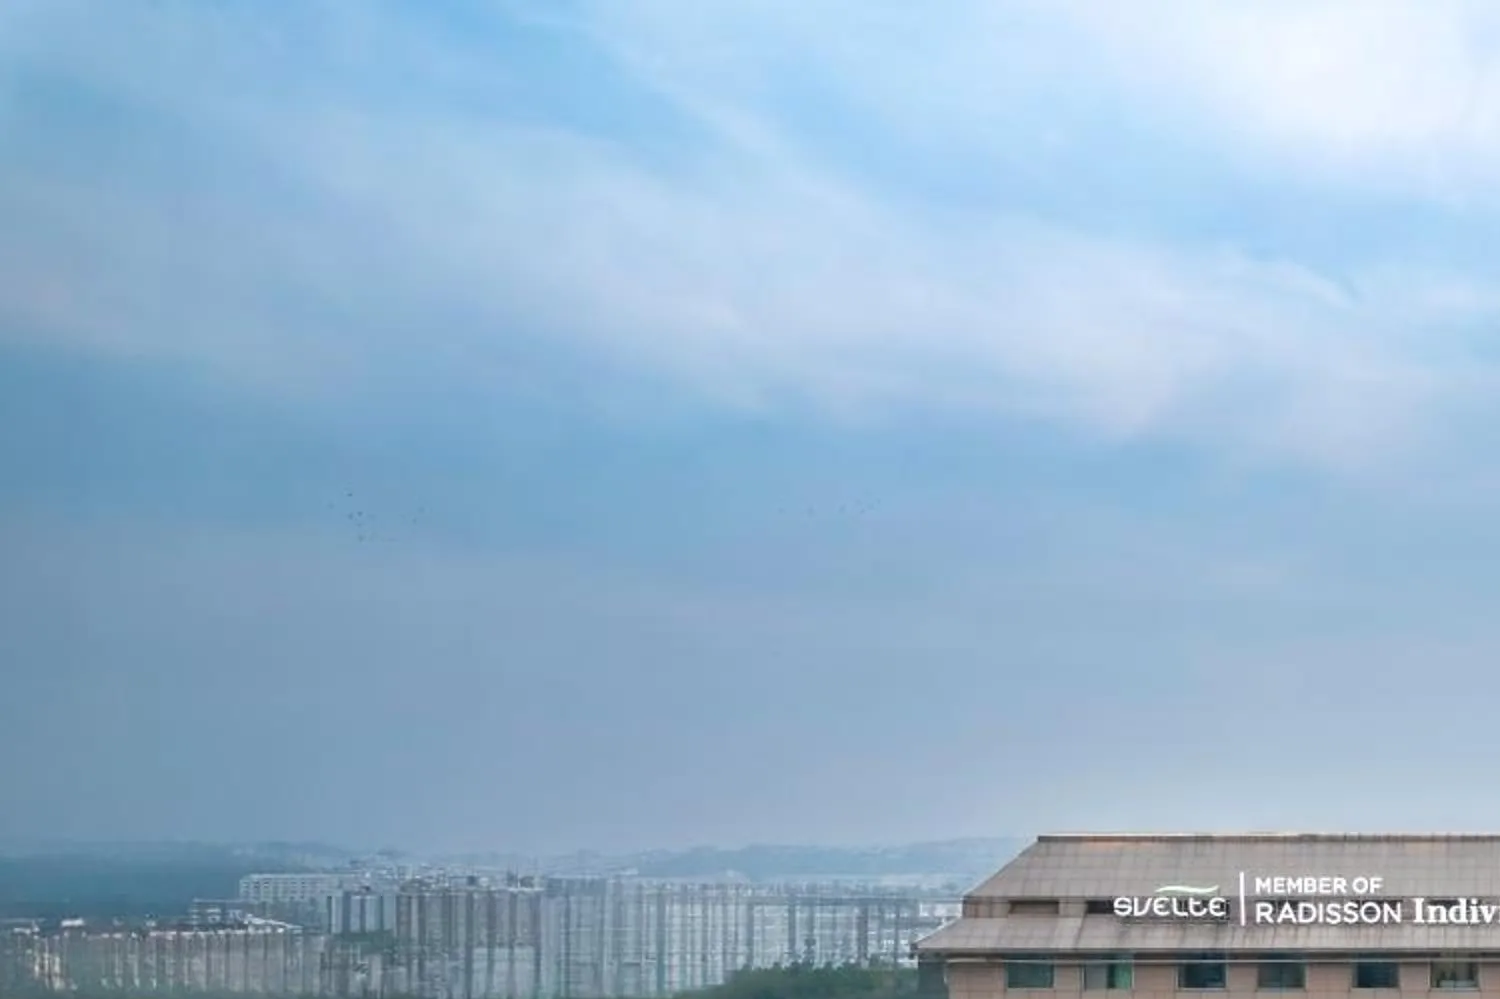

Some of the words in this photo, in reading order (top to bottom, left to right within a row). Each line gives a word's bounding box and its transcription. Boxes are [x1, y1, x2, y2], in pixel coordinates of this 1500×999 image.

[1255, 876, 1347, 894] MEMBER
[1352, 876, 1384, 894] OF
[1255, 901, 1402, 924] RADISSON
